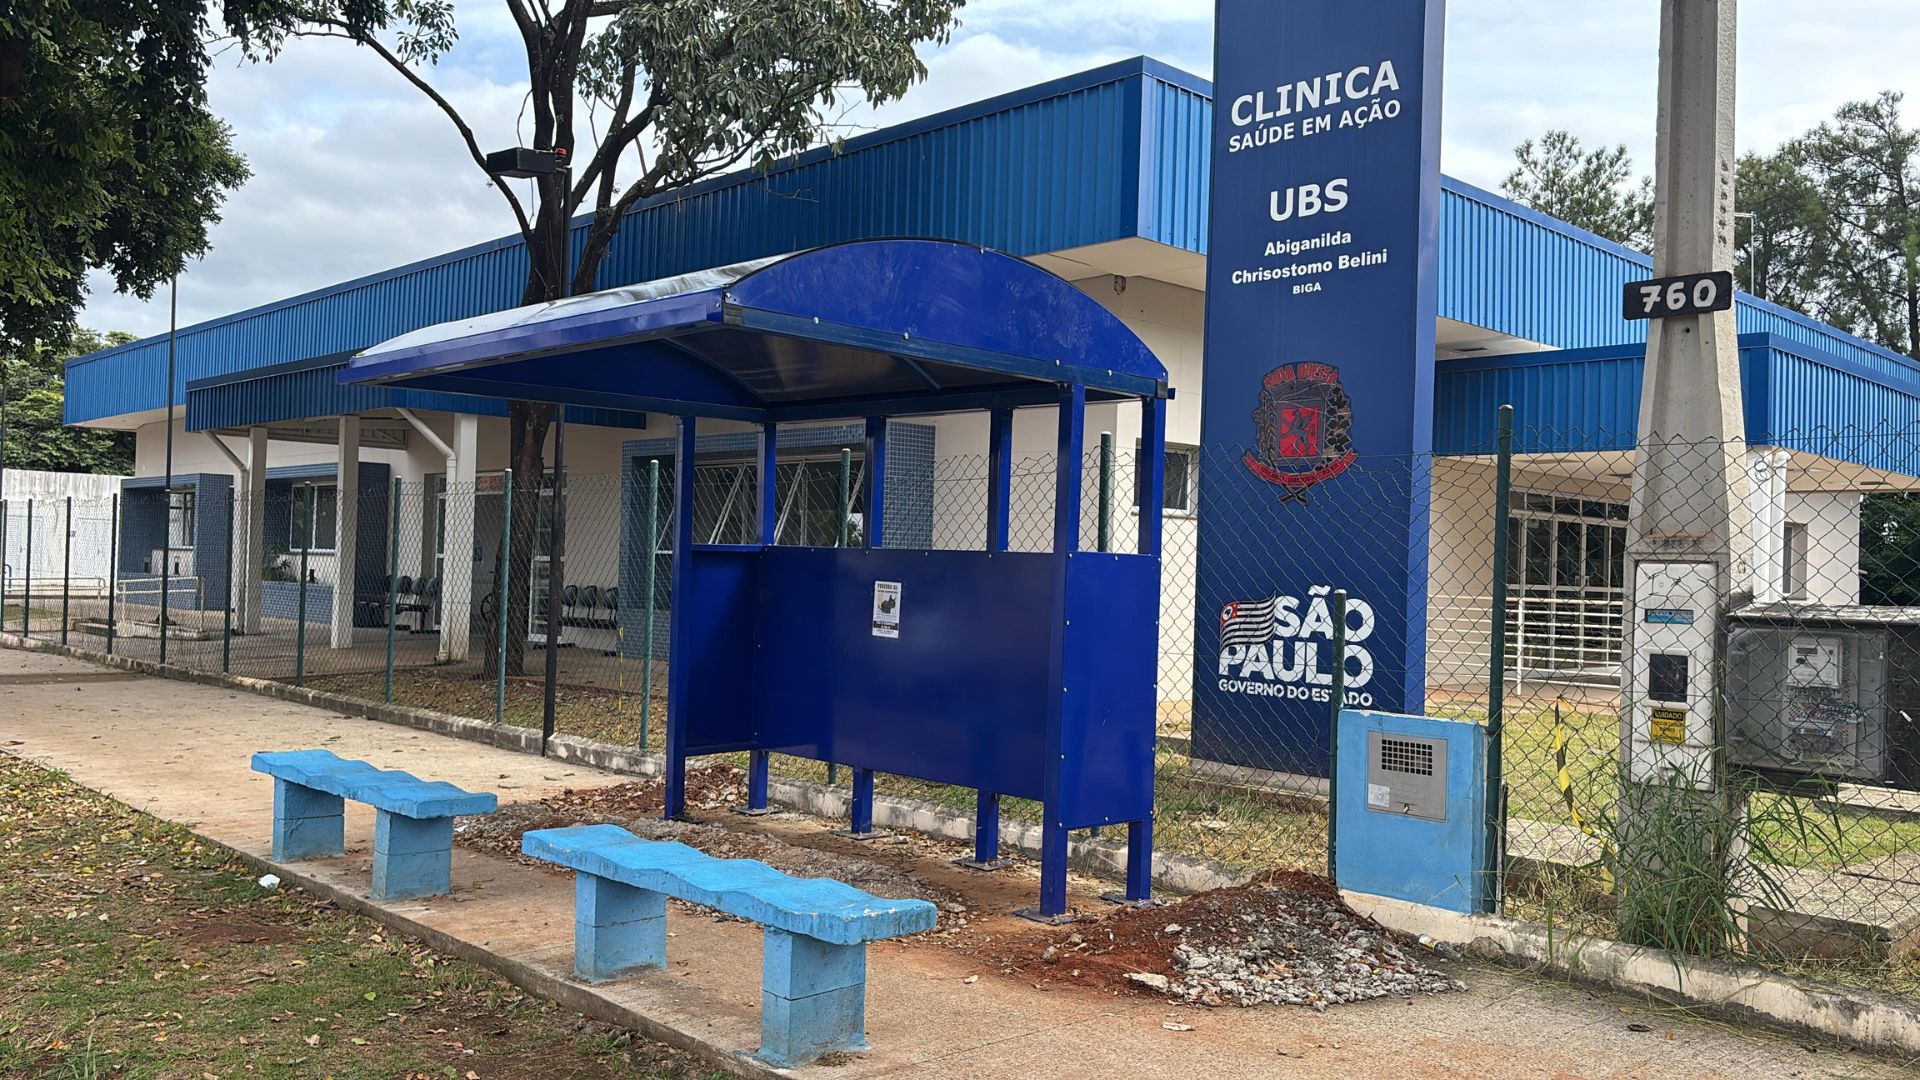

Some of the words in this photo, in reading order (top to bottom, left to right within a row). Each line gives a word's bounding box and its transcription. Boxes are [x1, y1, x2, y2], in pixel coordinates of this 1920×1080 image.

[1231, 60, 1400, 127] CLINICA
[1229, 122, 1295, 153] SAÚDE
[1302, 114, 1331, 137] EM
[1339, 98, 1401, 128] AÇÃO
[1269, 178, 1348, 222] UBS
[1264, 231, 1352, 256] Abiganilda
[1232, 261, 1333, 285] Chrisostomo
[1338, 248, 1388, 271] Belini
[1292, 282, 1322, 294] BIGA
[1640, 278, 1717, 313] 760
[1274, 585, 1375, 642] SÃO
[1218, 640, 1374, 688] PAULO
[1218, 678, 1285, 698] GOVERNO
[1287, 685, 1309, 700] DO
